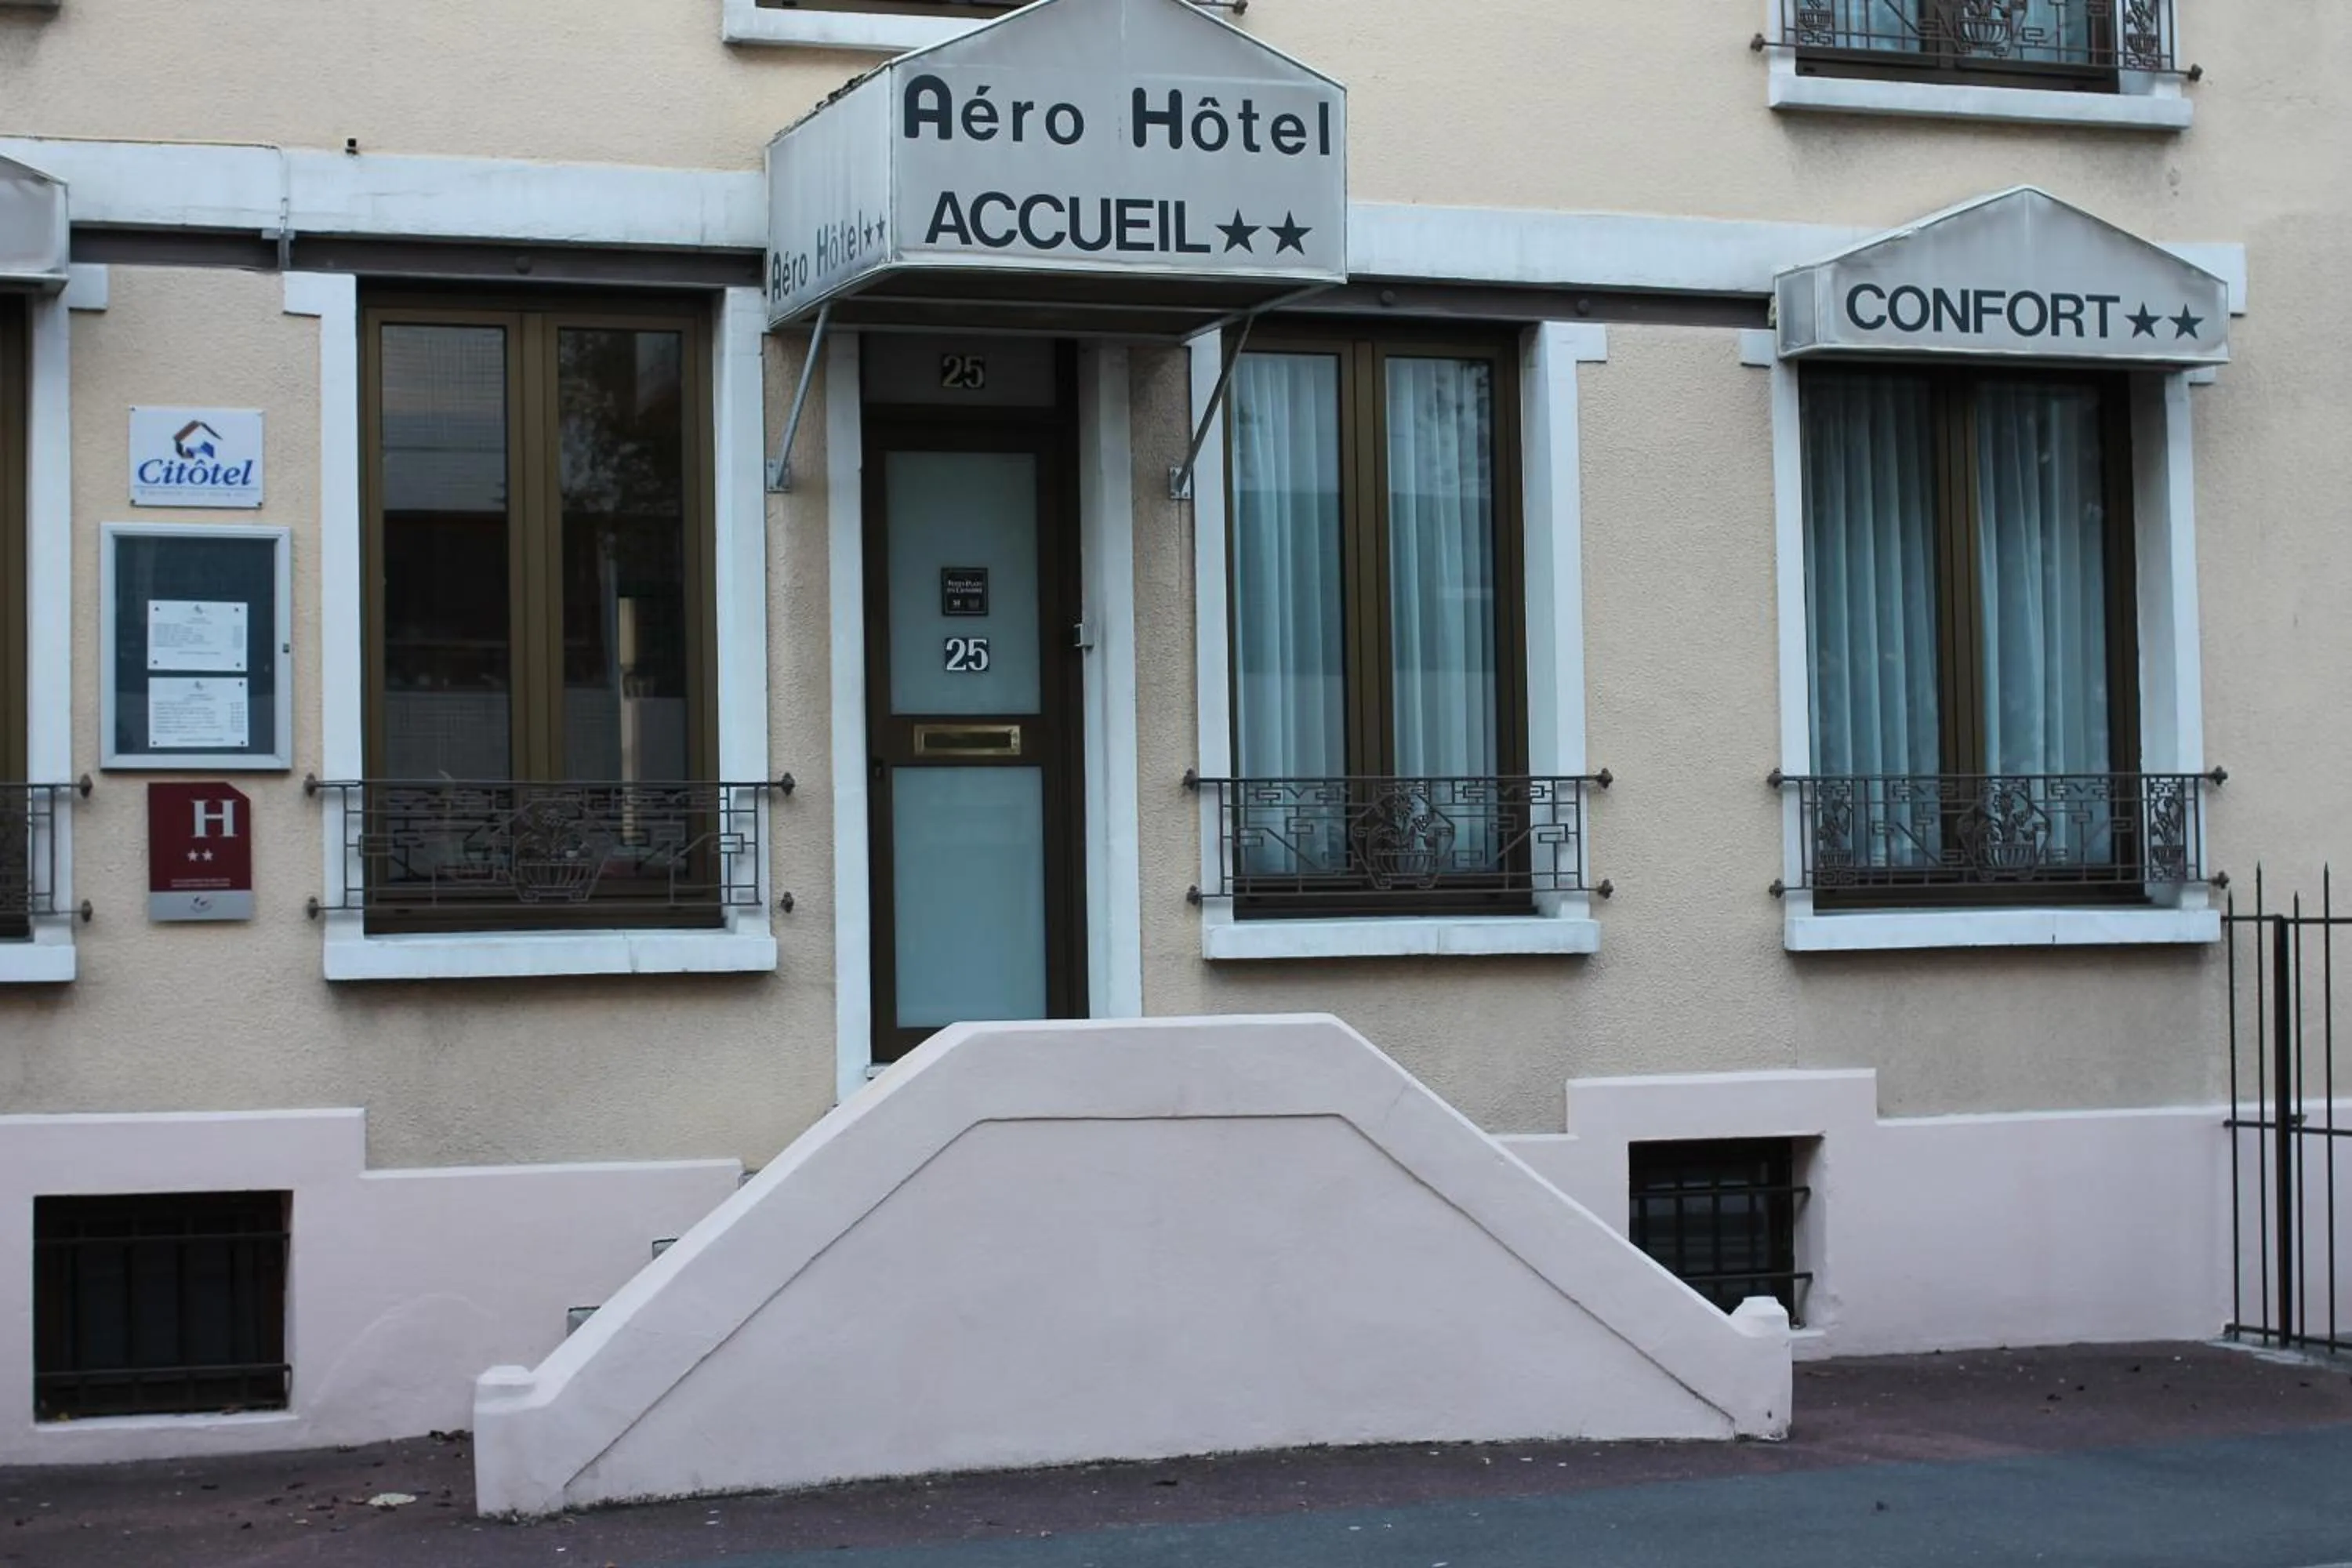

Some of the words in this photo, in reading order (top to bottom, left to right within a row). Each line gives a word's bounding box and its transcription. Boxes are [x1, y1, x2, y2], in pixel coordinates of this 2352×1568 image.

[904, 74, 1084, 144] Aéro
[1132, 87, 1330, 155] Hôtel
[925, 191, 1210, 253] ACCUEIL
[772, 251, 808, 303] Aéro
[817, 209, 862, 277] Hôtel
[1846, 283, 2120, 339] CONFORT
[942, 355, 983, 388] 25
[138, 459, 253, 485] Citôtel
[946, 639, 988, 670] 25
[191, 799, 238, 837] H
